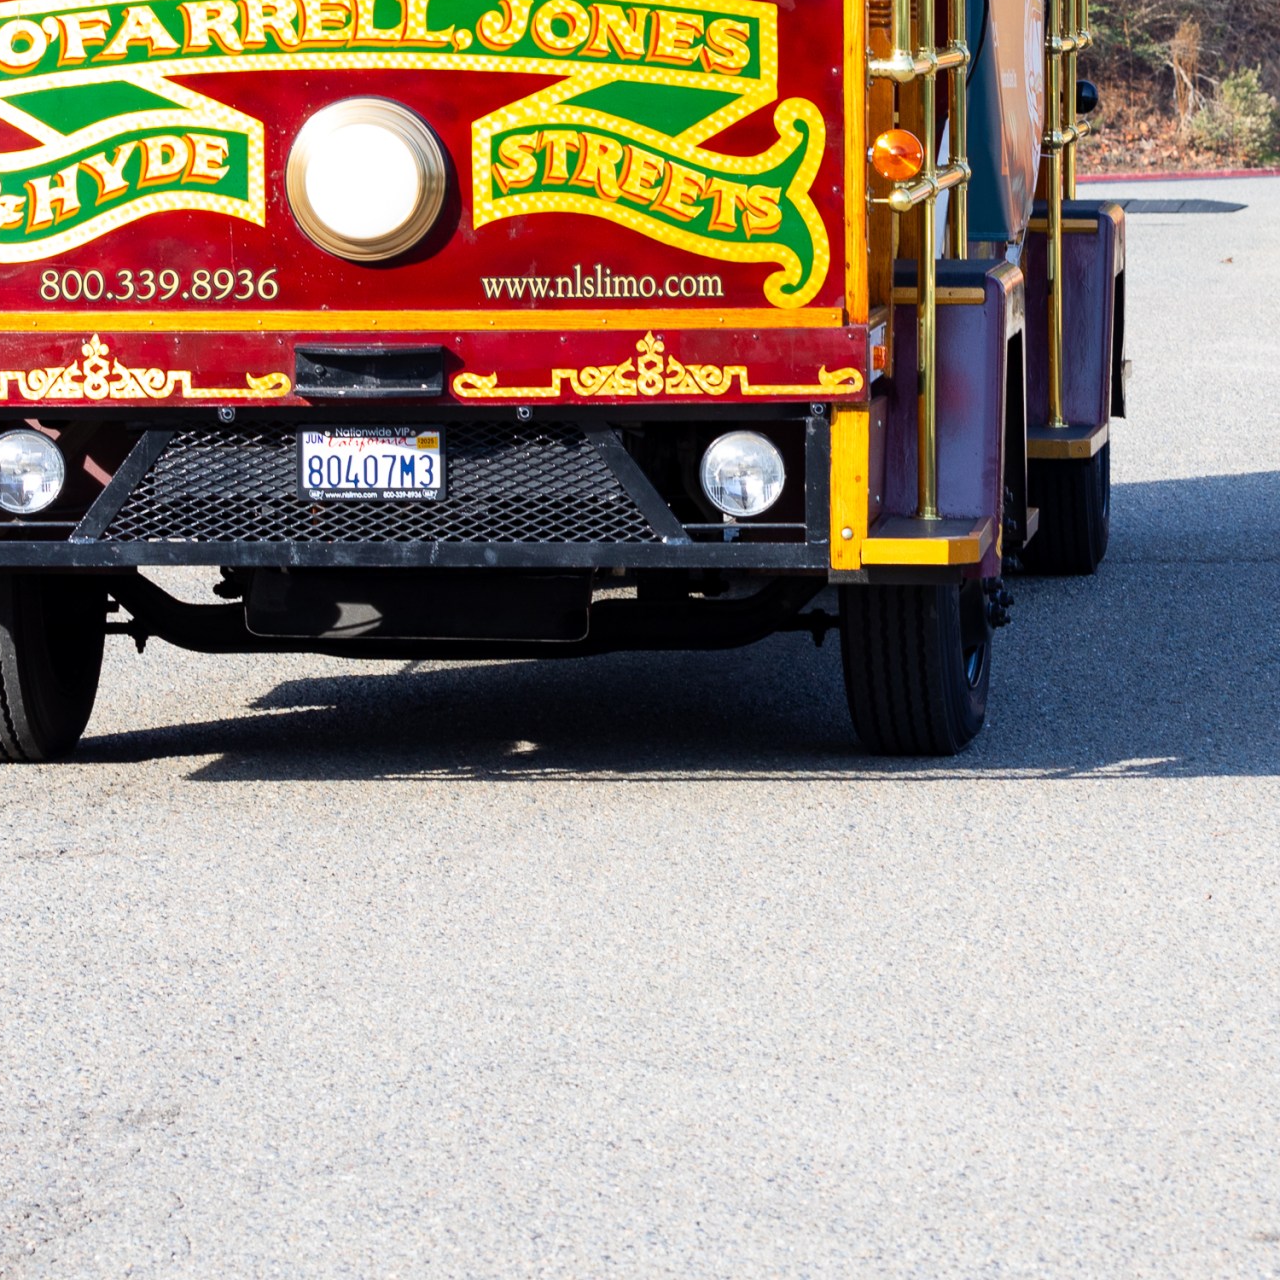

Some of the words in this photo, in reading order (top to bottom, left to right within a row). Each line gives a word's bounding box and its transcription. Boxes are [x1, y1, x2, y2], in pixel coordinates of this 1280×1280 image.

[491, 129, 783, 240] STREETS
[39, 268, 279, 302] 800.339.8936
[480, 262, 725, 300] www.nlslimo.com
[306, 434, 324, 444] JUN
[335, 426, 392, 437] Nationwide
[394, 426, 410, 437] VIP
[308, 454, 434, 488] 80407M3
